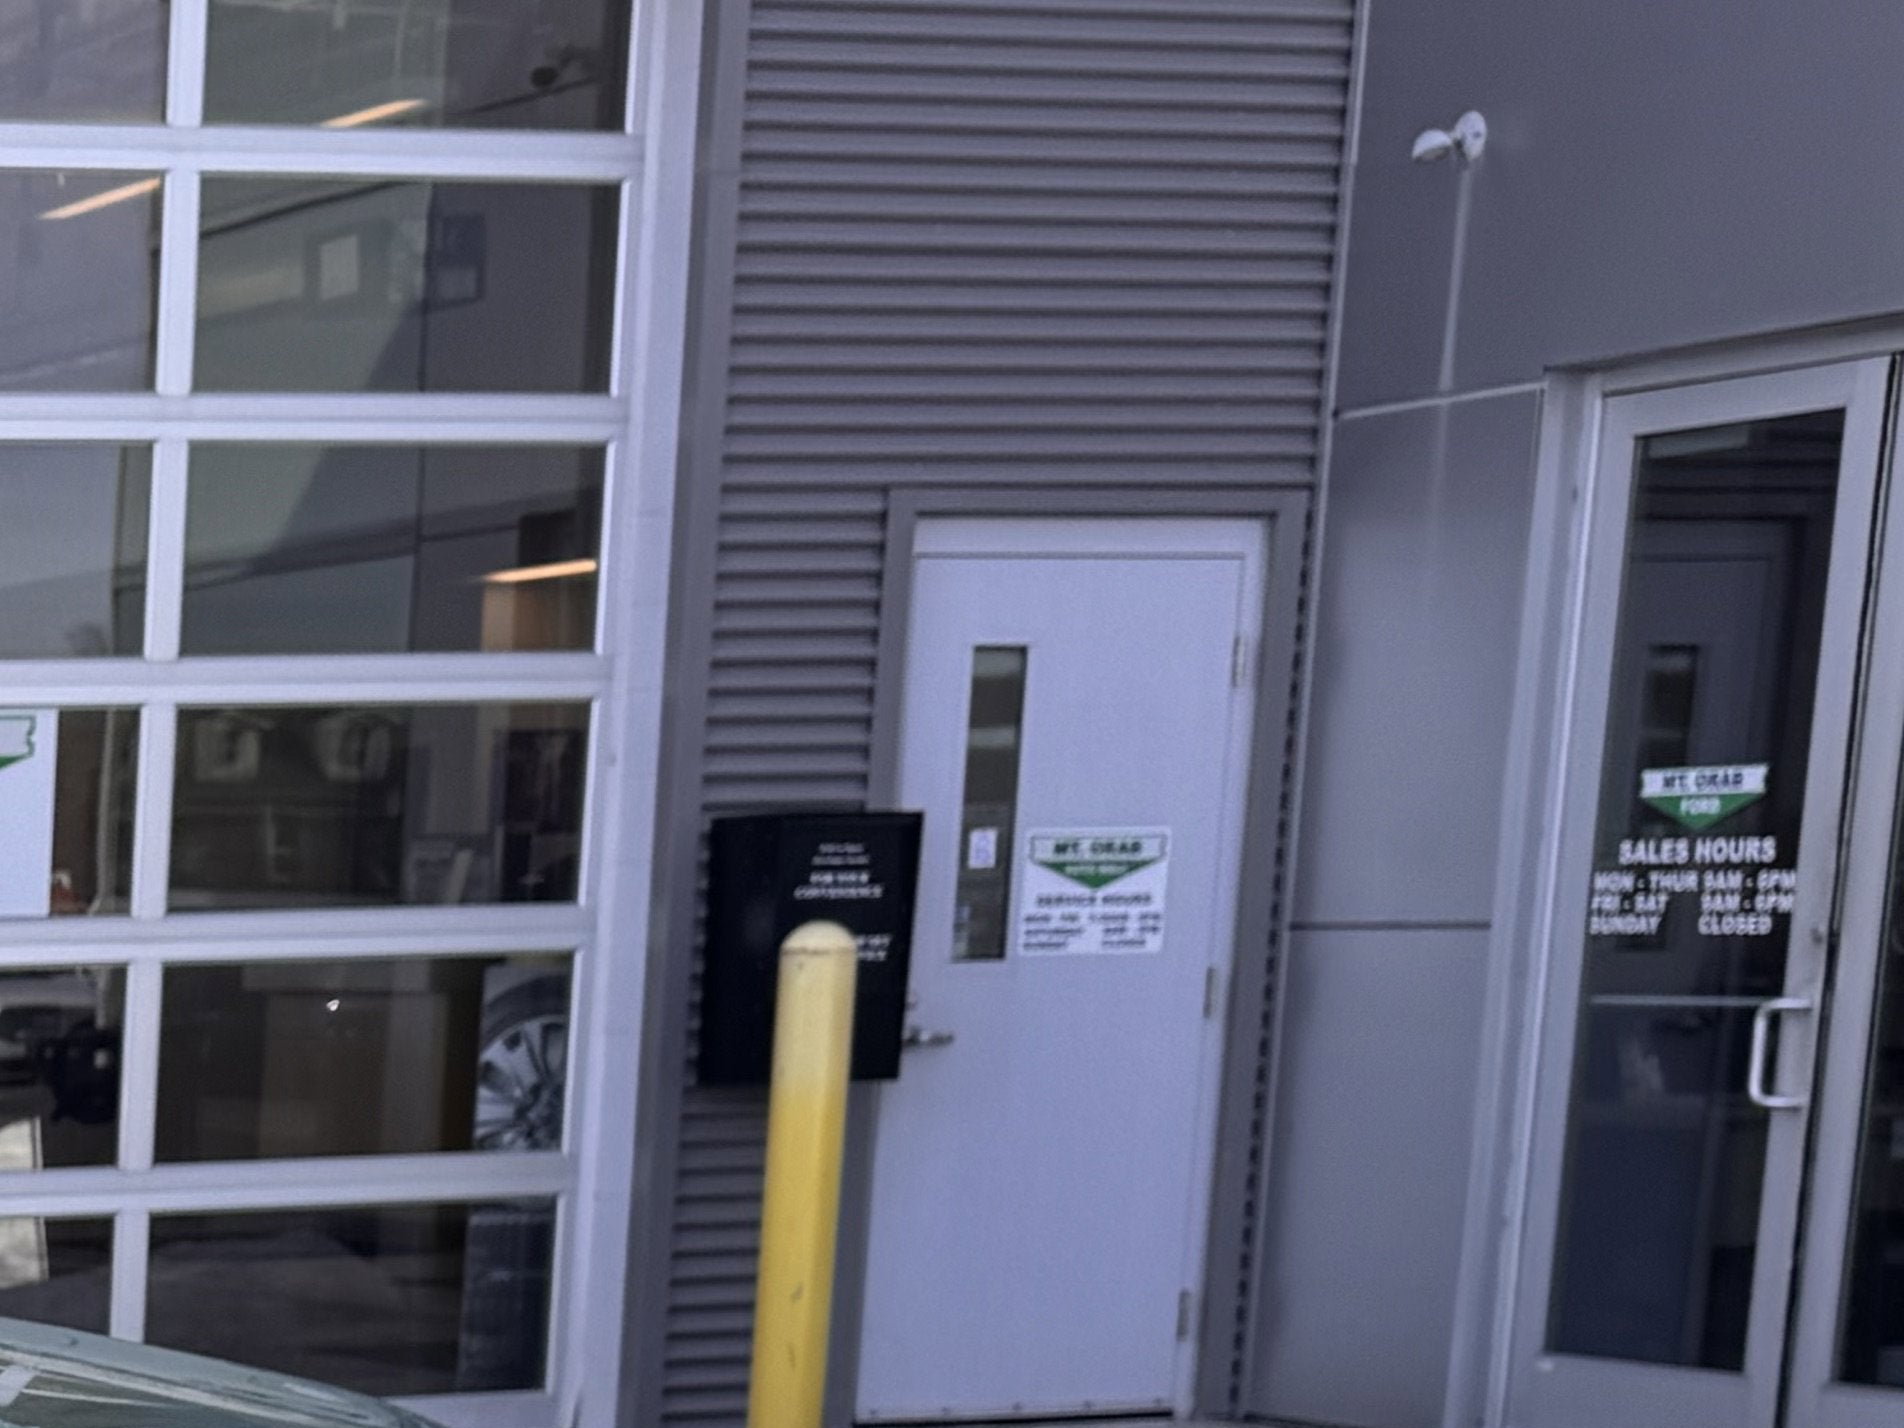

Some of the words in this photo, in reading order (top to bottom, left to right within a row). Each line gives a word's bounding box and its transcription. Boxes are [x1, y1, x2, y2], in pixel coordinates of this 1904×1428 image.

[1619, 838, 1689, 864] SALES
[1694, 836, 1777, 863] HOURS
[1698, 914, 1773, 936] CLOSED
